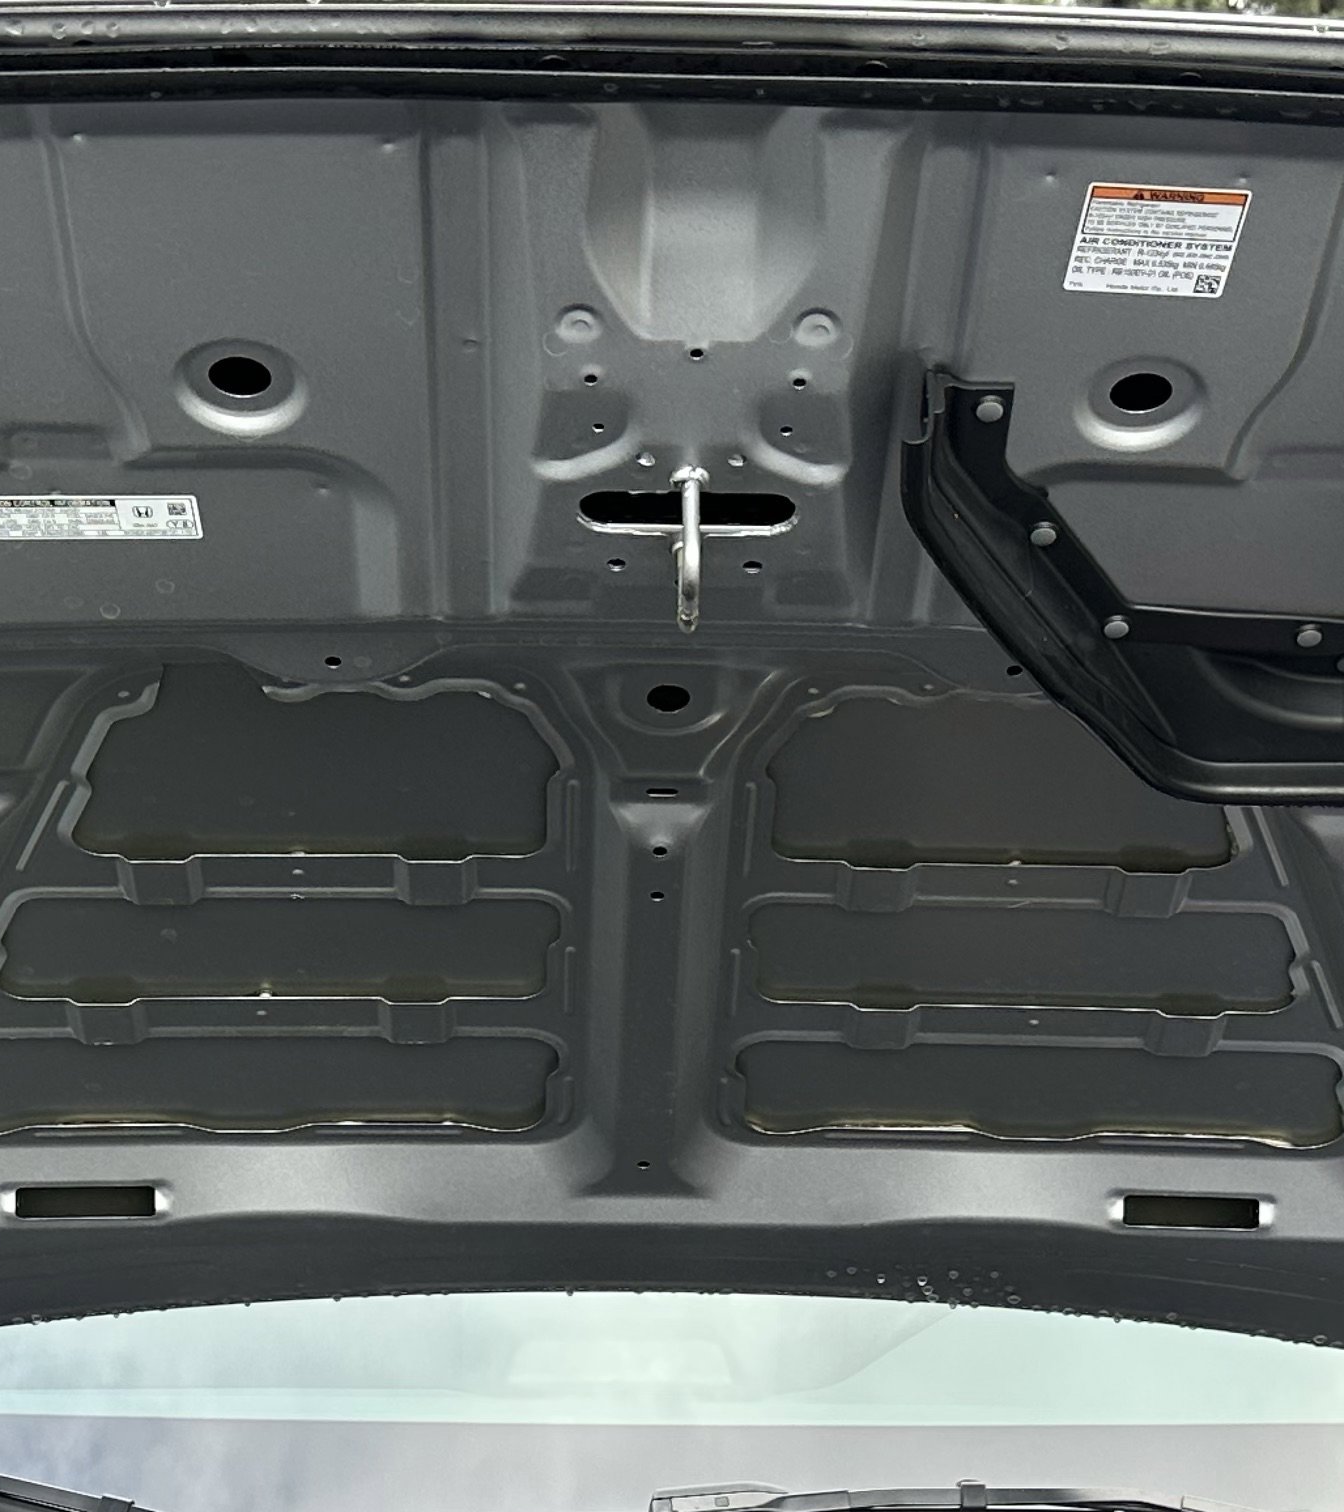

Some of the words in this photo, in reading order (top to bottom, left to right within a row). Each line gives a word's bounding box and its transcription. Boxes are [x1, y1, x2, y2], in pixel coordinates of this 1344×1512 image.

[1080, 237, 1100, 246] AIR
[1102, 238, 1183, 249] CONDITIONER
[1185, 242, 1233, 251] SYSTEM
